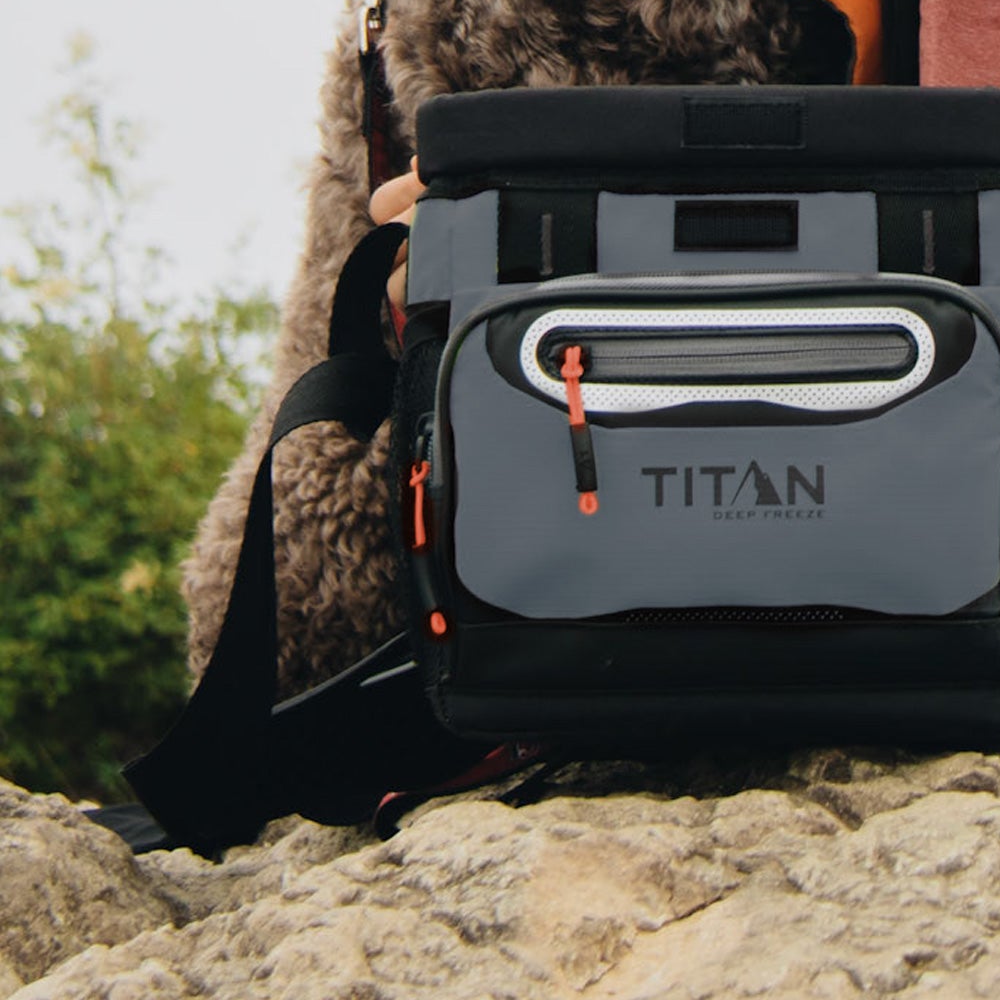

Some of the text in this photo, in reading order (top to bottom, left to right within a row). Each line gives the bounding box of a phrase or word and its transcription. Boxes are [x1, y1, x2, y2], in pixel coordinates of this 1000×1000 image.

[641, 459, 825, 507] TITAN
[713, 509, 826, 520] DEEP FREEZE
